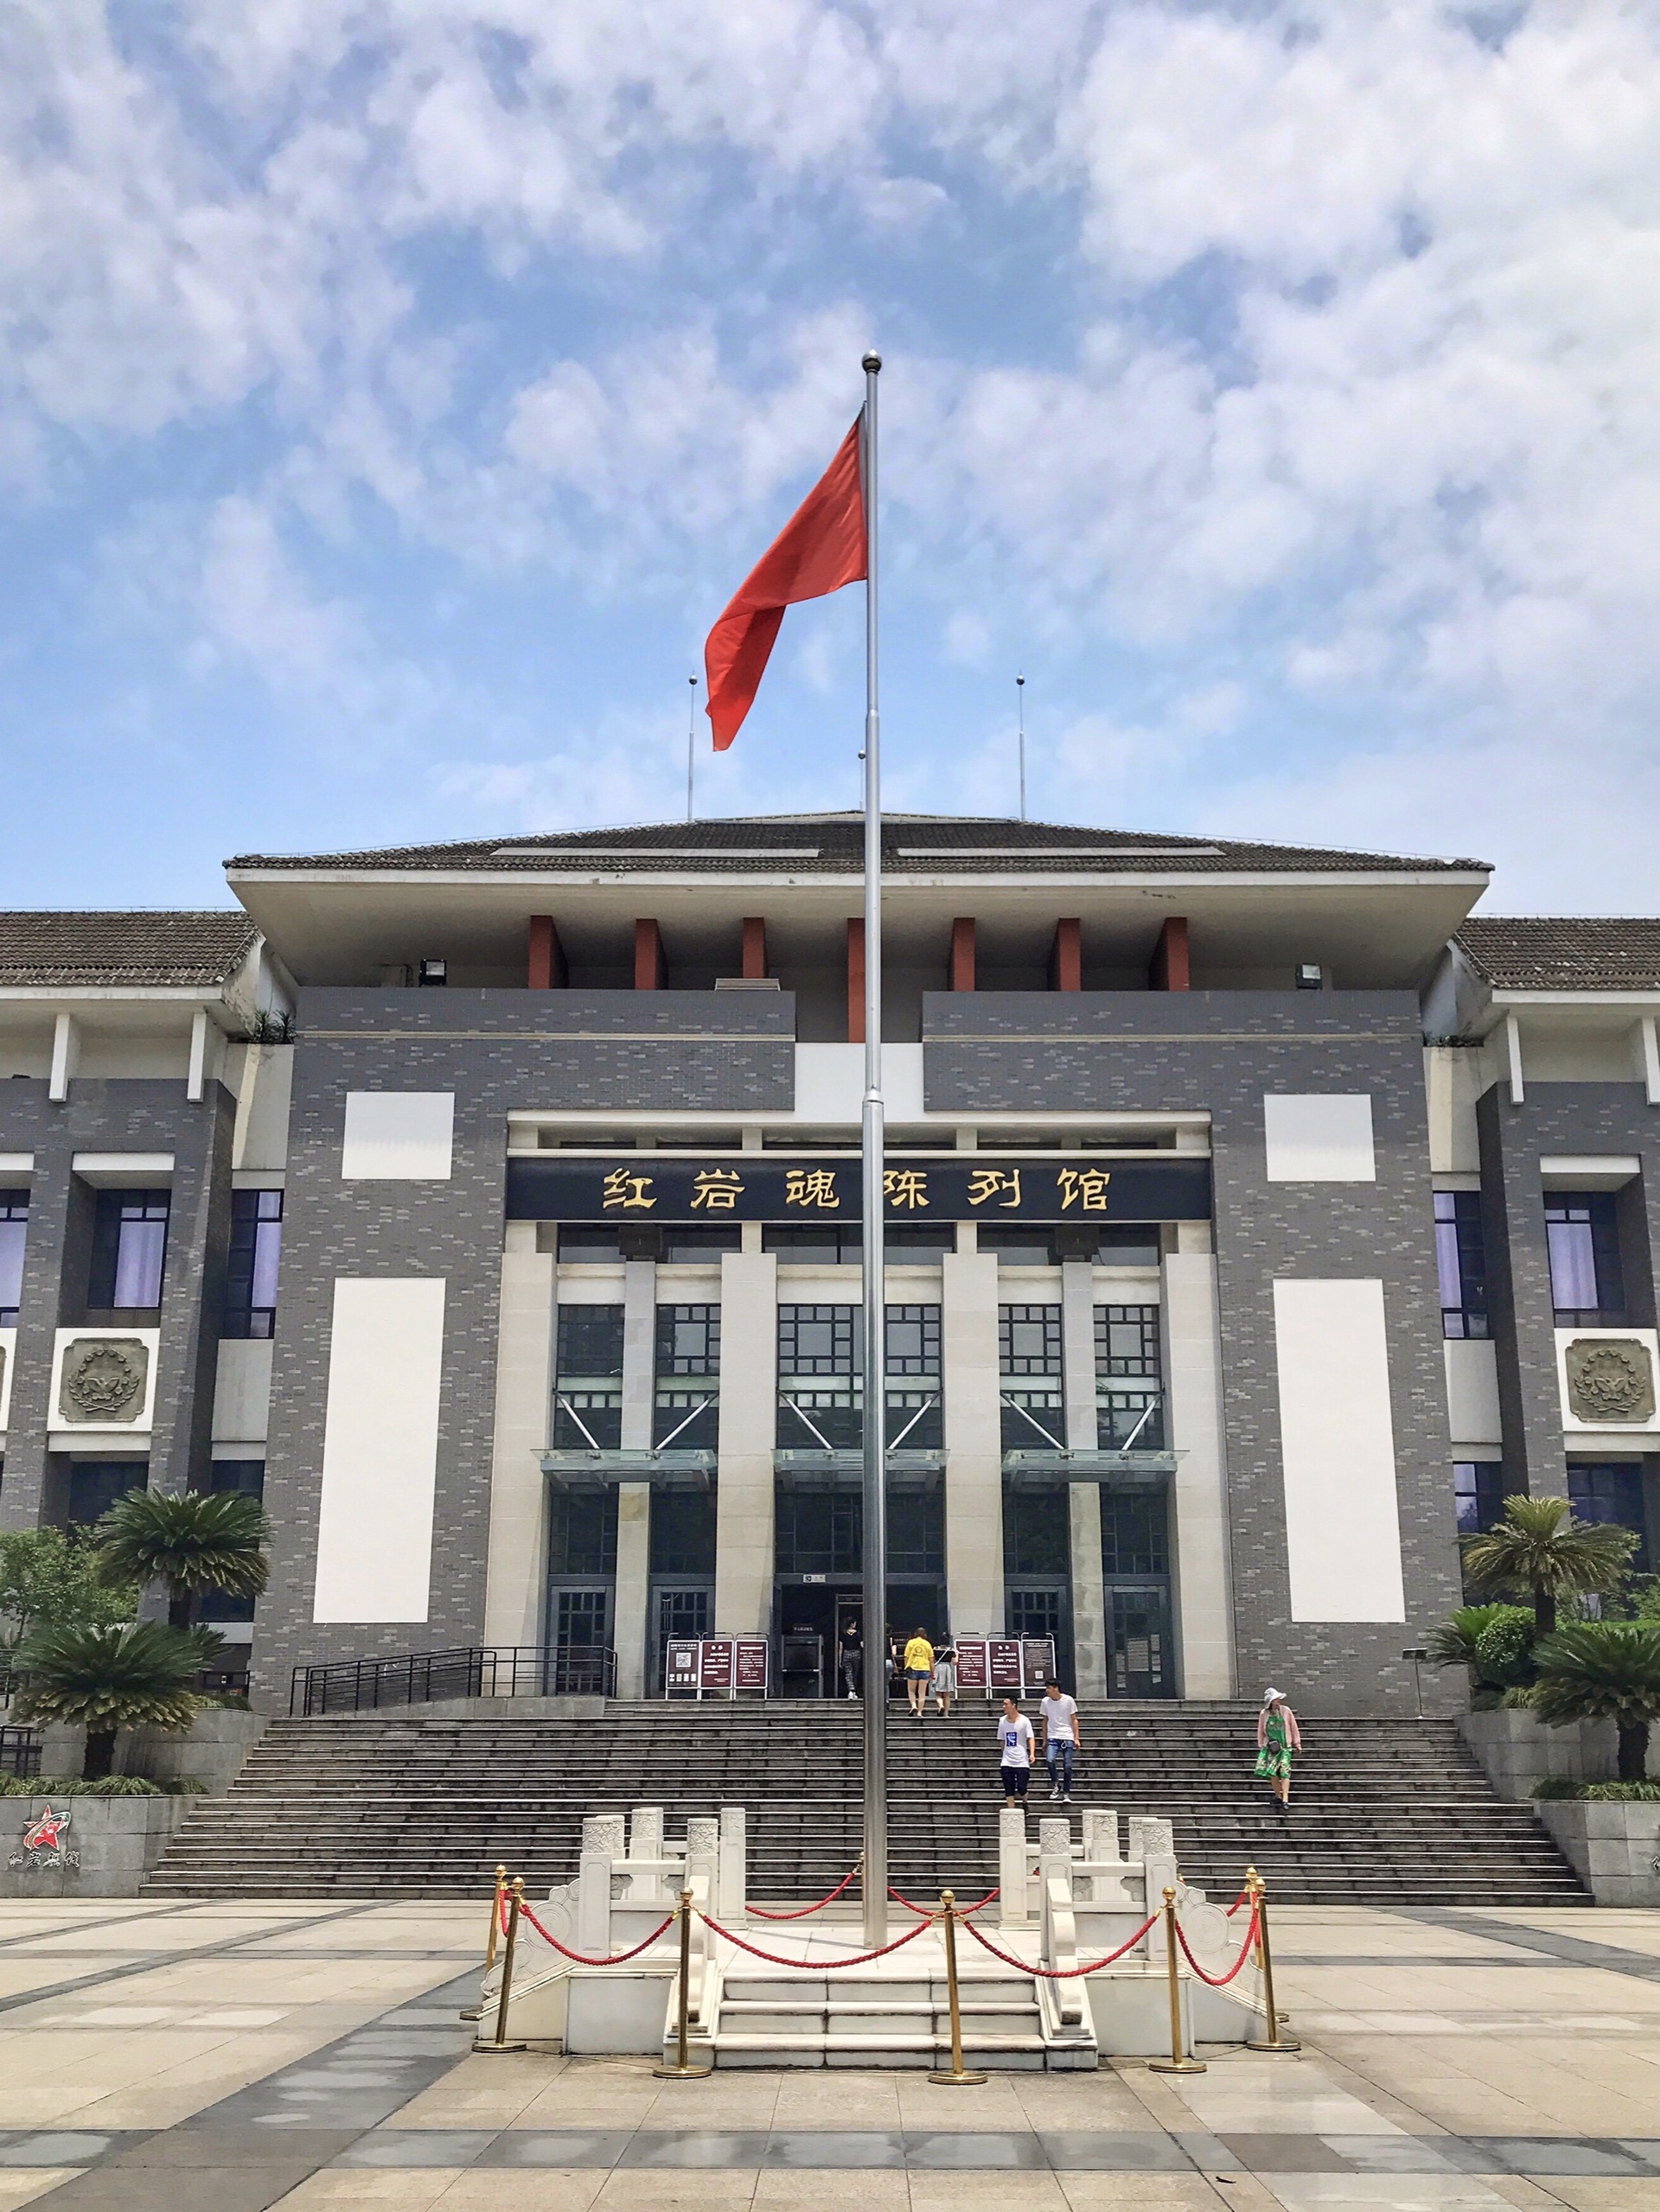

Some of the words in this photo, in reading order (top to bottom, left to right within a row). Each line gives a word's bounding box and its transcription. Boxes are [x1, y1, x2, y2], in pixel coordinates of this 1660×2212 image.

[603, 1168, 1111, 1210] 红岩魂陈列馆
